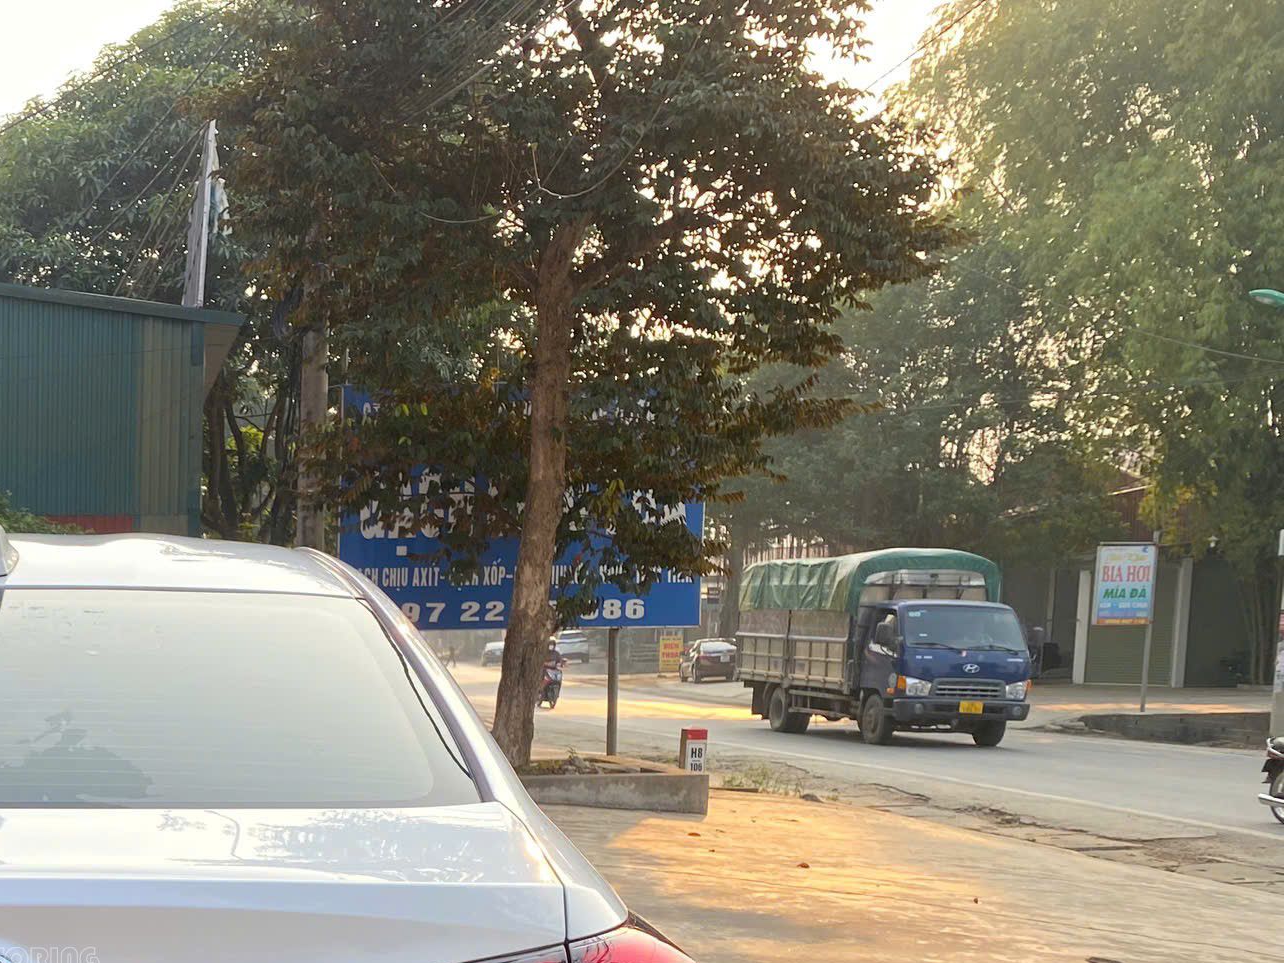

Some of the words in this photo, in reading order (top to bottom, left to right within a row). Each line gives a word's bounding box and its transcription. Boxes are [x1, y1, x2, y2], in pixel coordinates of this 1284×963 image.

[382, 567, 408, 591] CHỊU
[459, 601, 505, 622] 22
[690, 747, 703, 759] H8
